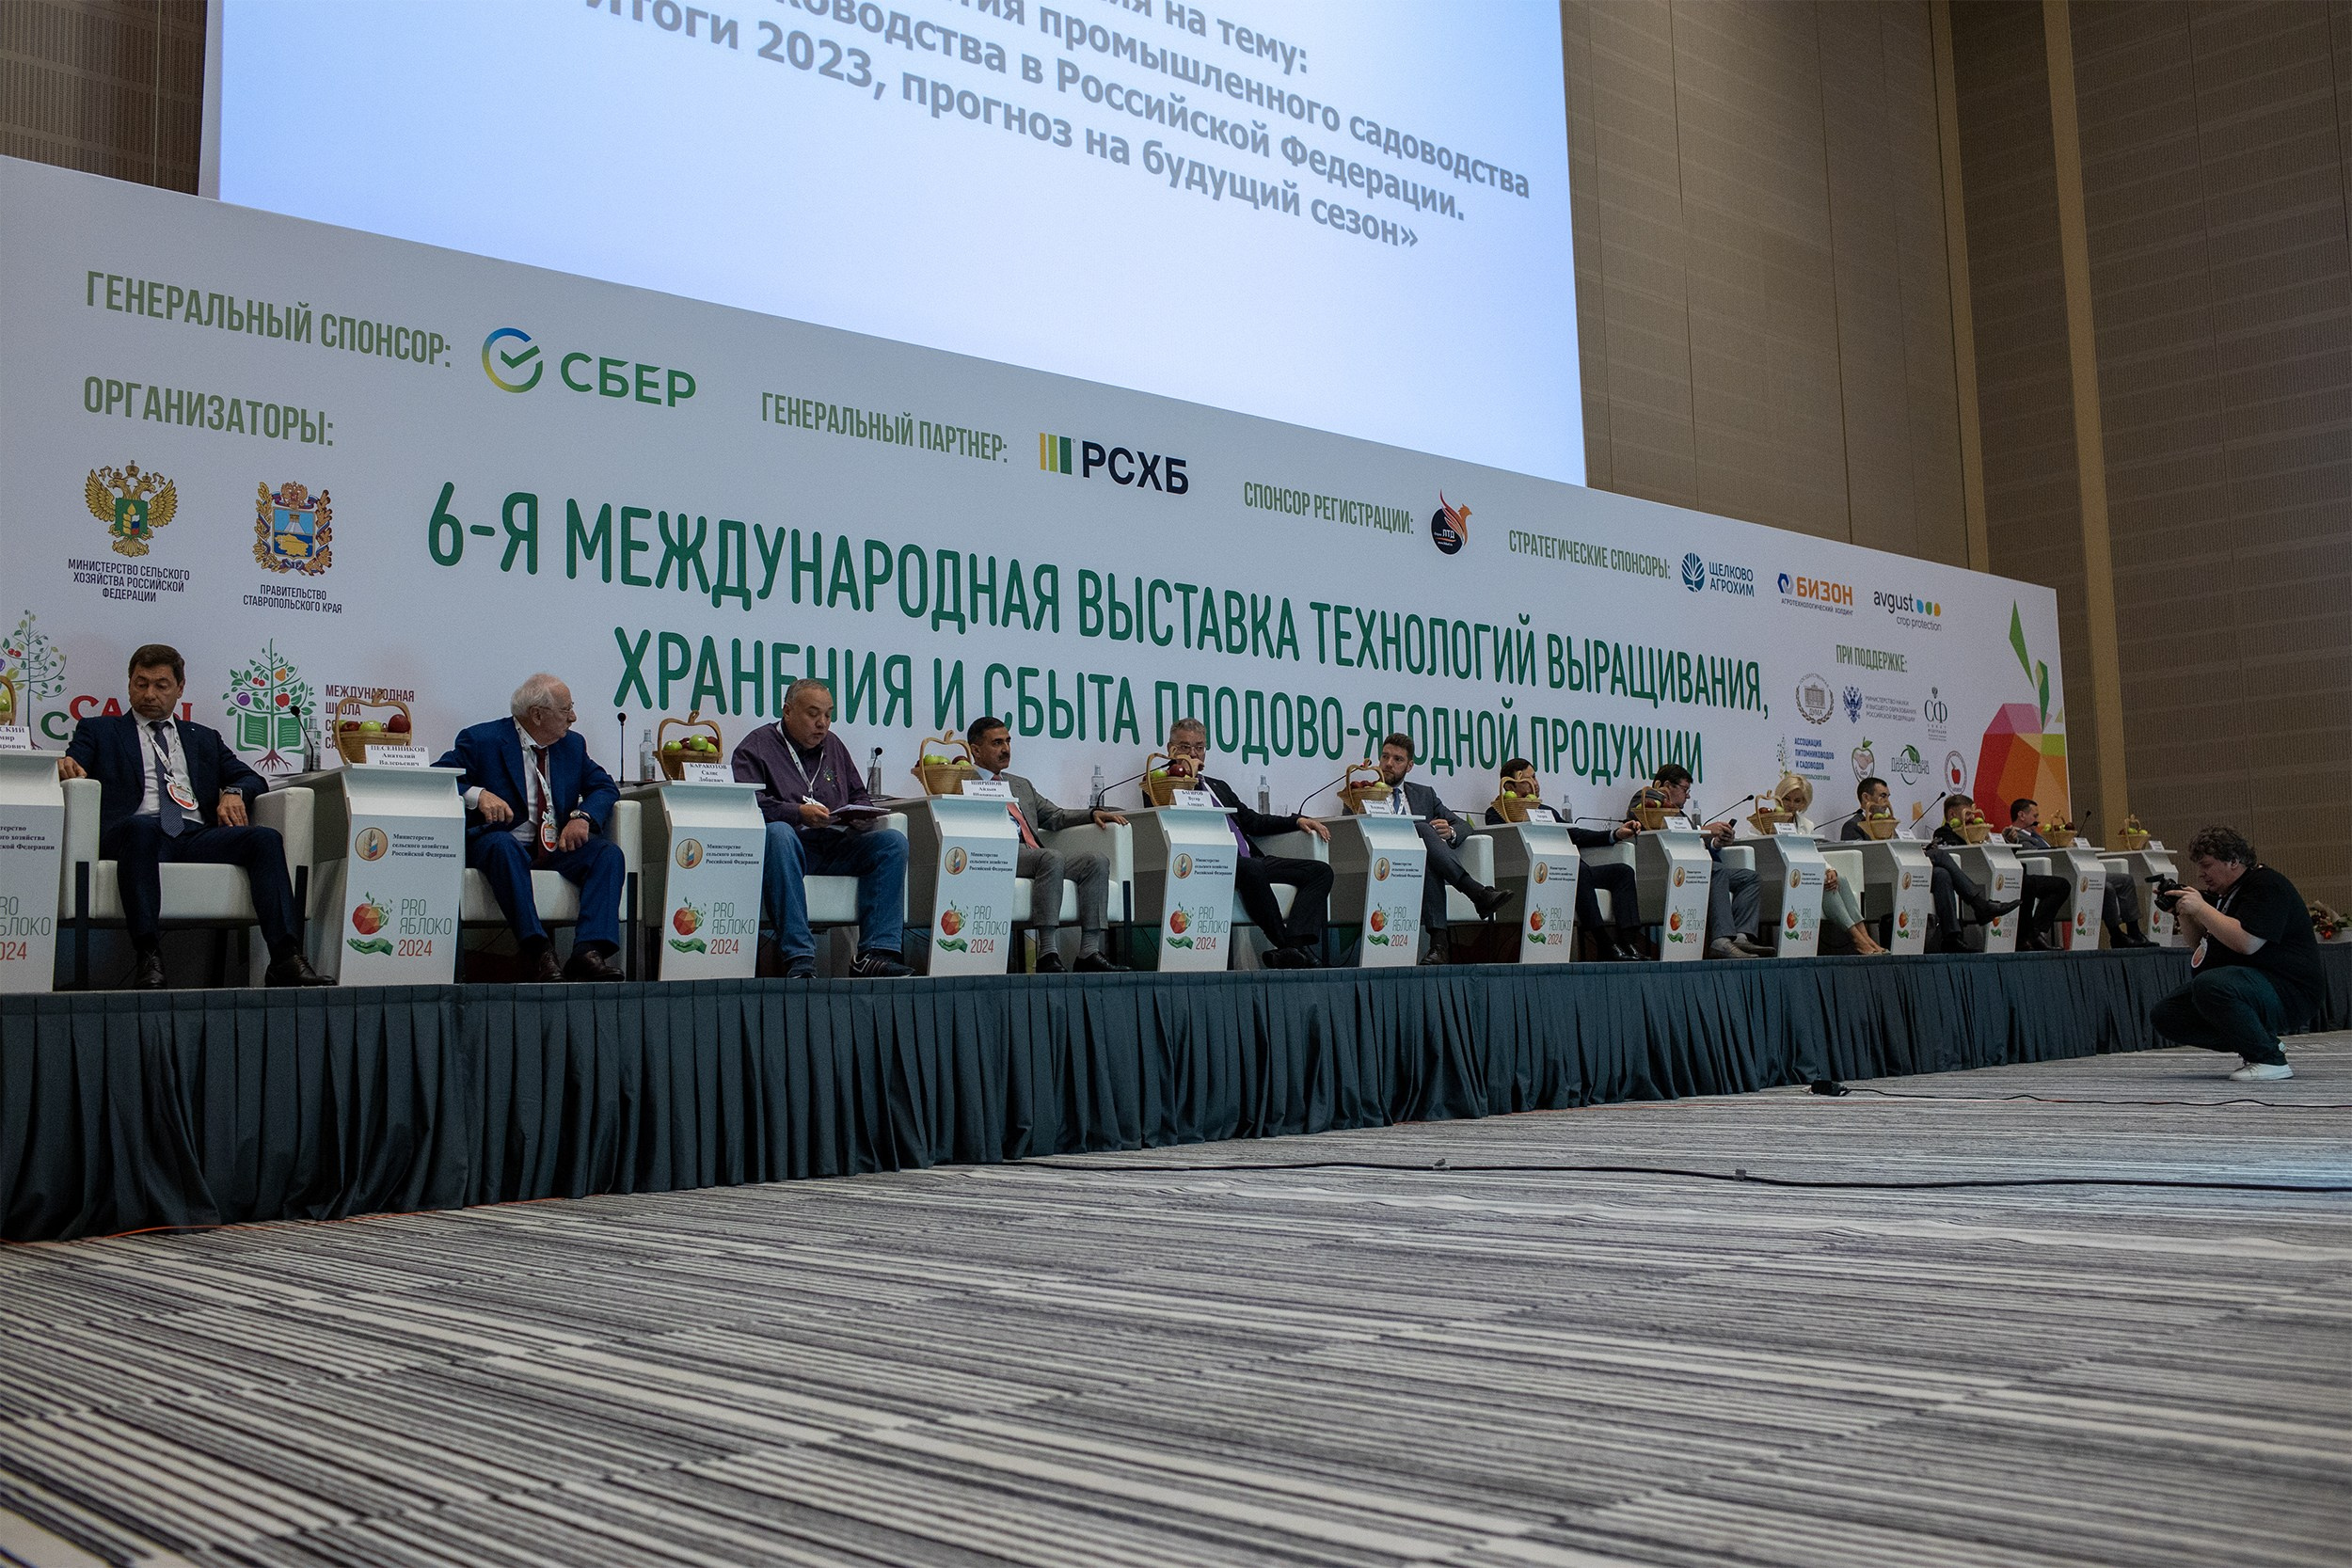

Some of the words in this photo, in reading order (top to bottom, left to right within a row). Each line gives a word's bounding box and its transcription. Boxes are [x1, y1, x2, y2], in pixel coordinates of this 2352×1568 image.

[1166, 0, 1205, 37] на
[1216, 18, 1307, 75] тему:
[1040, 6, 1341, 132] промышленного
[1350, 115, 1530, 198] садоводства
[756, 21, 887, 101] 2023,
[902, 71, 1073, 149] прогноз
[1086, 127, 1130, 166] на
[1142, 139, 1300, 217] будущий
[1311, 198, 1419, 247] сезон»
[1021, 54, 1043, 84] в
[1057, 57, 1270, 158] Российской
[1280, 135, 1465, 221] Федерации.
[87, 270, 312, 344] ГЕНЕРАЛЬНЫЙ
[321, 312, 452, 368] СПОНСОР:
[560, 351, 697, 408] СБЕР
[84, 375, 334, 447] ОРГАНИЗАТОРЫ:
[761, 391, 914, 448] ГЕНЕРАЛЬНЫЙ
[918, 420, 1009, 464] ПАРТНЕР:
[1081, 440, 1189, 496] РСХБ
[1244, 481, 1311, 517] СПОНСОР
[1313, 494, 1414, 535] РЕГИСТРАЦИИ:
[1509, 529, 1608, 569] СТРАТЕГИЧЕСКИЕ
[1610, 548, 1671, 580] СПОНСОРЫ:
[68, 558, 138, 576] МИНИСТЕРСТВО
[140, 565, 190, 581] СЕЛЬСКОГО
[1708, 561, 1754, 582] ЩЕЛКОВО
[73, 571, 125, 588] ХОЗЯЙСТВА
[127, 577, 184, 593] РОССИЙСКОЙ
[1709, 578, 1755, 598] АГРОХИМ
[1796, 576, 1853, 607] БИЗОН
[102, 587, 157, 602] ФЕДЕРАЦИИ
[260, 584, 327, 601] ПРАВИТЕЛЬСТВО
[428, 481, 538, 576] 6-Я
[565, 497, 1060, 636] МЕЖДУНАРОДНАЯ
[1077, 567, 1301, 661] ВЫСТАВКА
[1309, 601, 1537, 688] ТЕХНОЛОГИЙ
[1548, 632, 1770, 721] ВЫРАЩИВАНИЯ,
[1873, 590, 1915, 614] avgust
[243, 594, 321, 611] СТАВРОПОЛЬСКОГО
[322, 603, 342, 614] КРАЯ
[1896, 616, 1911, 627] crop
[1911, 617, 1942, 632] protection
[1836, 644, 1853, 666] ПРИ
[1854, 646, 1908, 673] ПОДДЕРЖКЕ:
[326, 684, 415, 703] МЕЖДУНАОДНАЯ
[933, 657, 964, 732] И
[984, 662, 1140, 745] СБЫТА
[1924, 699, 1948, 723] СФ
[1794, 737, 1822, 748] АССОЦИАЦИЯ
[401, 898, 427, 916] PRO
[712, 902, 734, 918] PRO
[974, 905, 992, 920] PRO
[1199, 906, 1214, 920] PRO
[399, 917, 453, 935] ЯБЛОКО
[711, 918, 755, 935] ЯБЛОКО
[972, 921, 1009, 936] ЯБЛОКО
[1197, 920, 1229, 934] ЯБЛОКО
[398, 939, 433, 957] 2024
[709, 939, 739, 955] 2024
[970, 939, 994, 953] 2024
[1196, 936, 1216, 950] 2024
[1391, 934, 1408, 947] 2024
